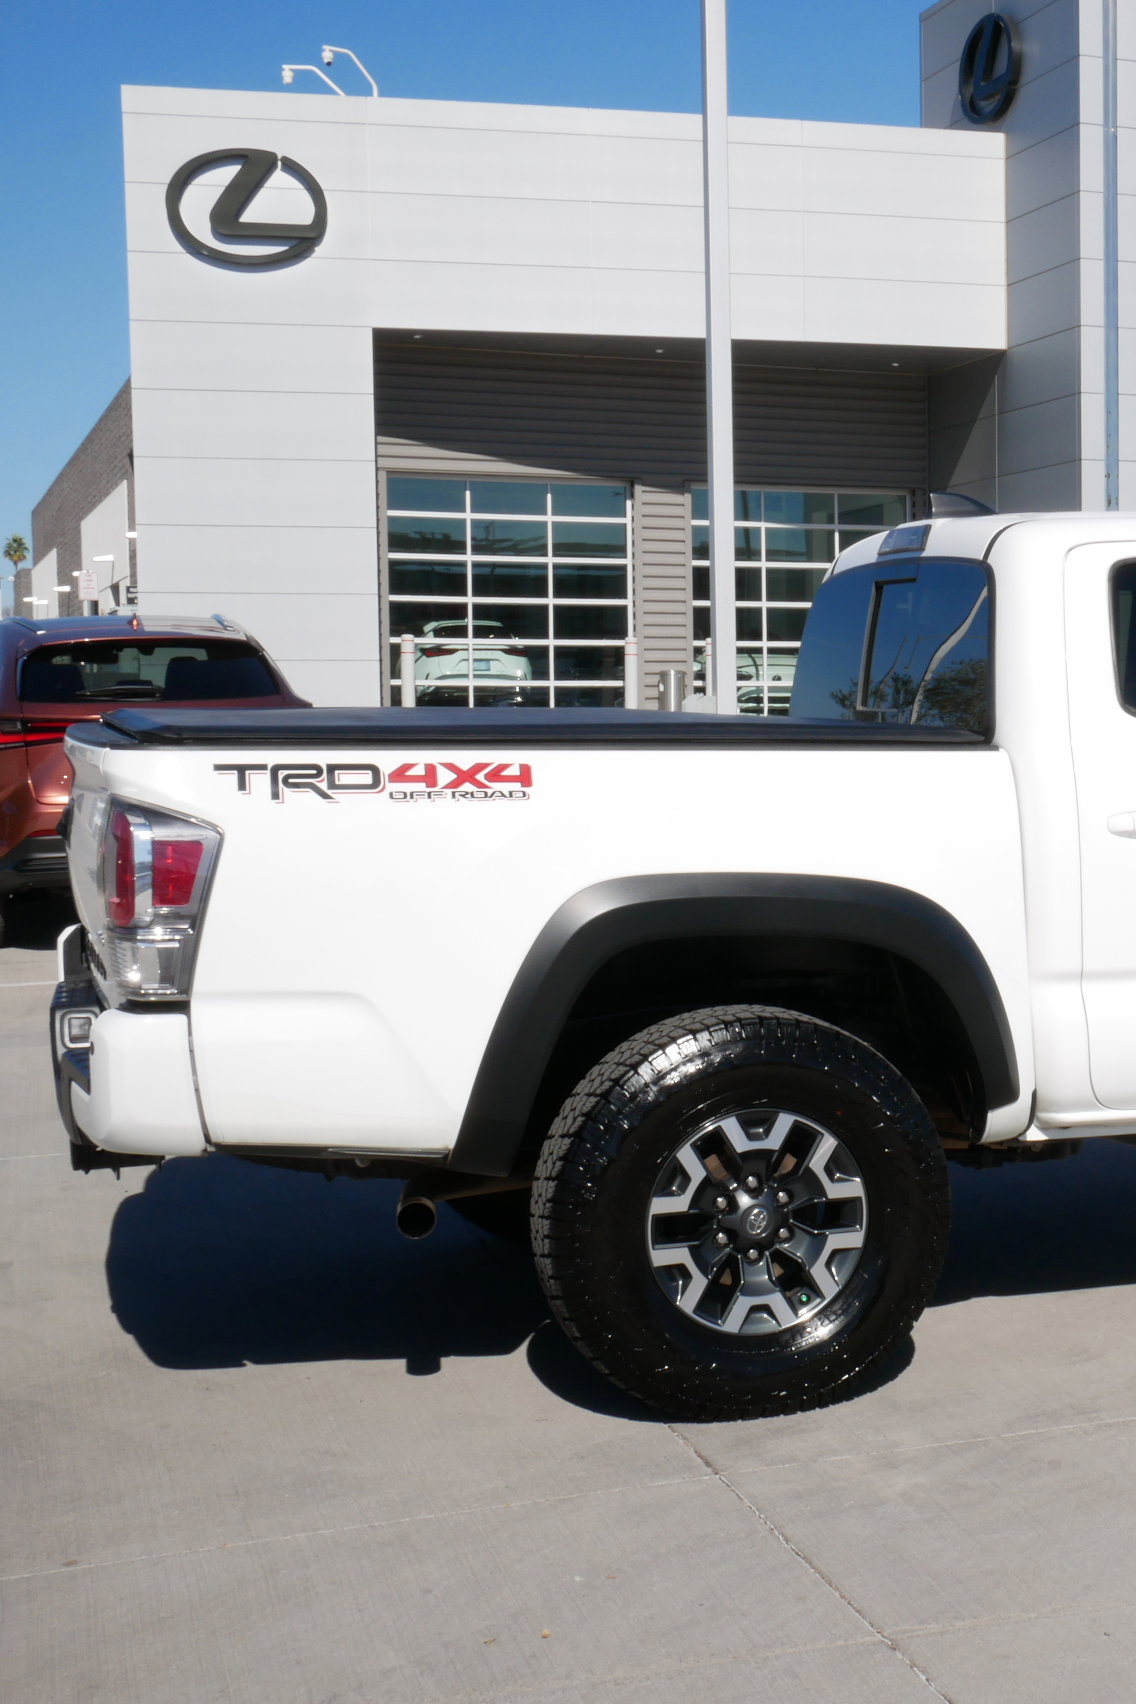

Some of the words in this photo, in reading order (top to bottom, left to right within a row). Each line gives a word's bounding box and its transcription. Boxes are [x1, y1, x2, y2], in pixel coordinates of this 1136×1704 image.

[213, 763, 386, 803] TRD
[387, 762, 533, 790] 4X4
[389, 790, 446, 802] OFF
[451, 790, 529, 801] ROAD
